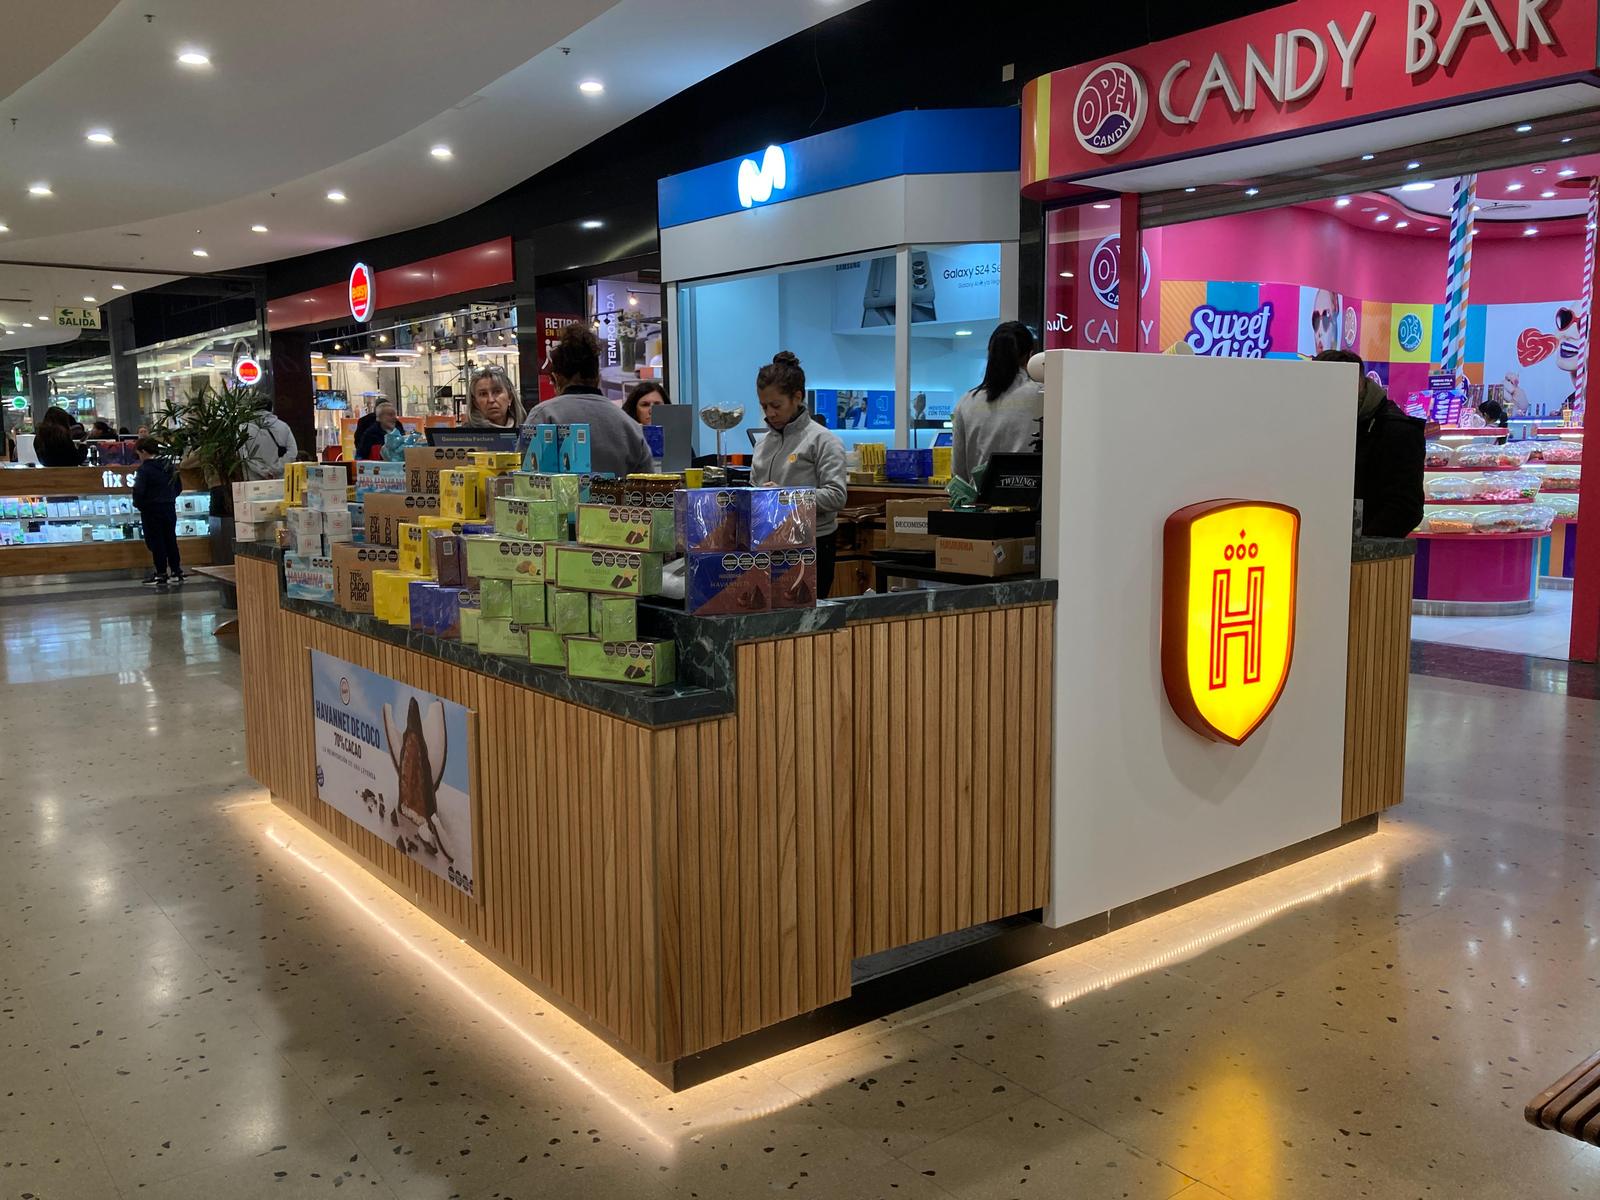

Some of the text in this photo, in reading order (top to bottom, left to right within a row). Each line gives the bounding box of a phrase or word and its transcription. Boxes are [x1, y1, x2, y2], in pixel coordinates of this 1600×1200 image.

[1159, 0, 1556, 124] CANDY BAR
[1093, 120, 1128, 147] CANDY
[943, 263, 1001, 280] Galaxy S24 Se
[58, 317, 97, 327] SALIDA
[1187, 305, 1271, 353] Sweet
[102, 470, 122, 488] fix
[1000, 476, 1037, 487] TWININGS
[350, 571, 363, 583] 70%
[350, 582, 370, 593] CACAO
[350, 591, 367, 602] PURO
[1209, 566, 1265, 690] H
[315, 700, 380, 750] HAVANNET DE COCO
[333, 732, 362, 759] 70% CACAO
